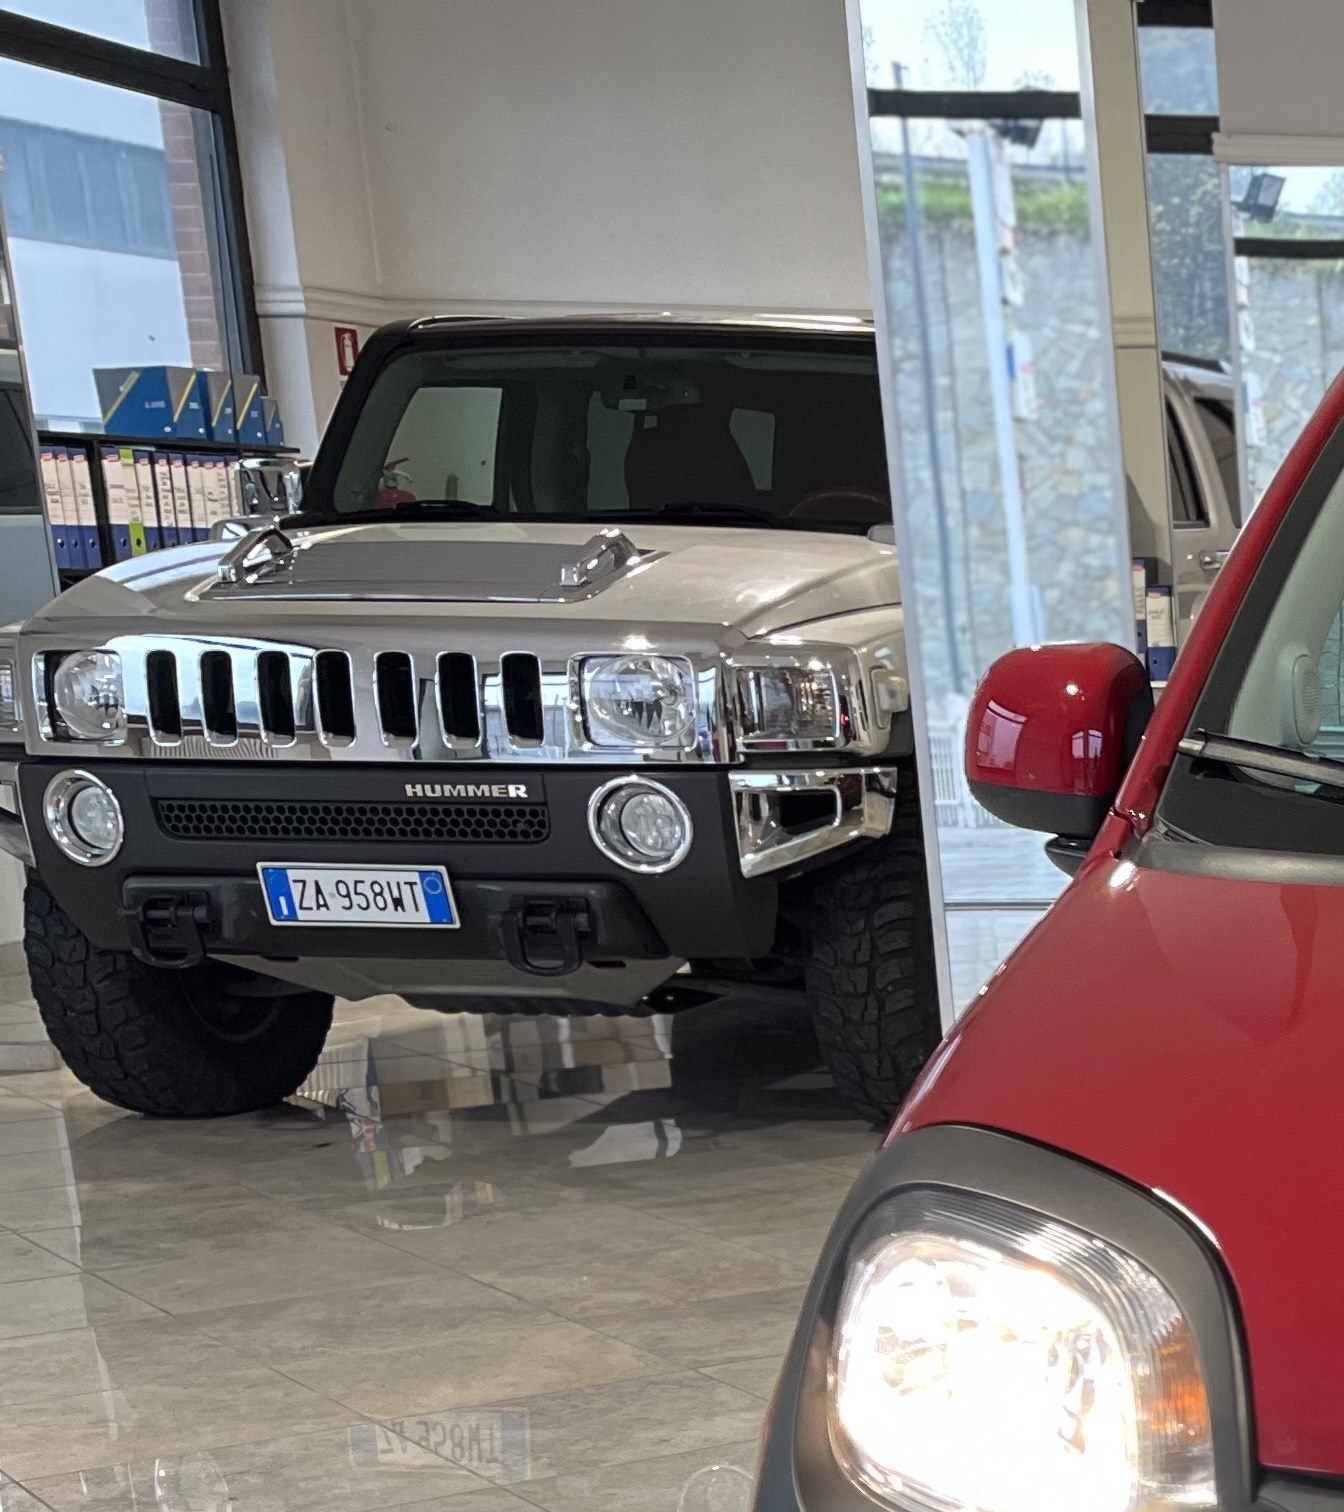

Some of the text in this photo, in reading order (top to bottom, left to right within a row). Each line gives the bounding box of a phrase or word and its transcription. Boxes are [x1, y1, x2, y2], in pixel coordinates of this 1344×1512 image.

[405, 784, 528, 798] HUMMER
[292, 878, 420, 913] ZA 958WT
